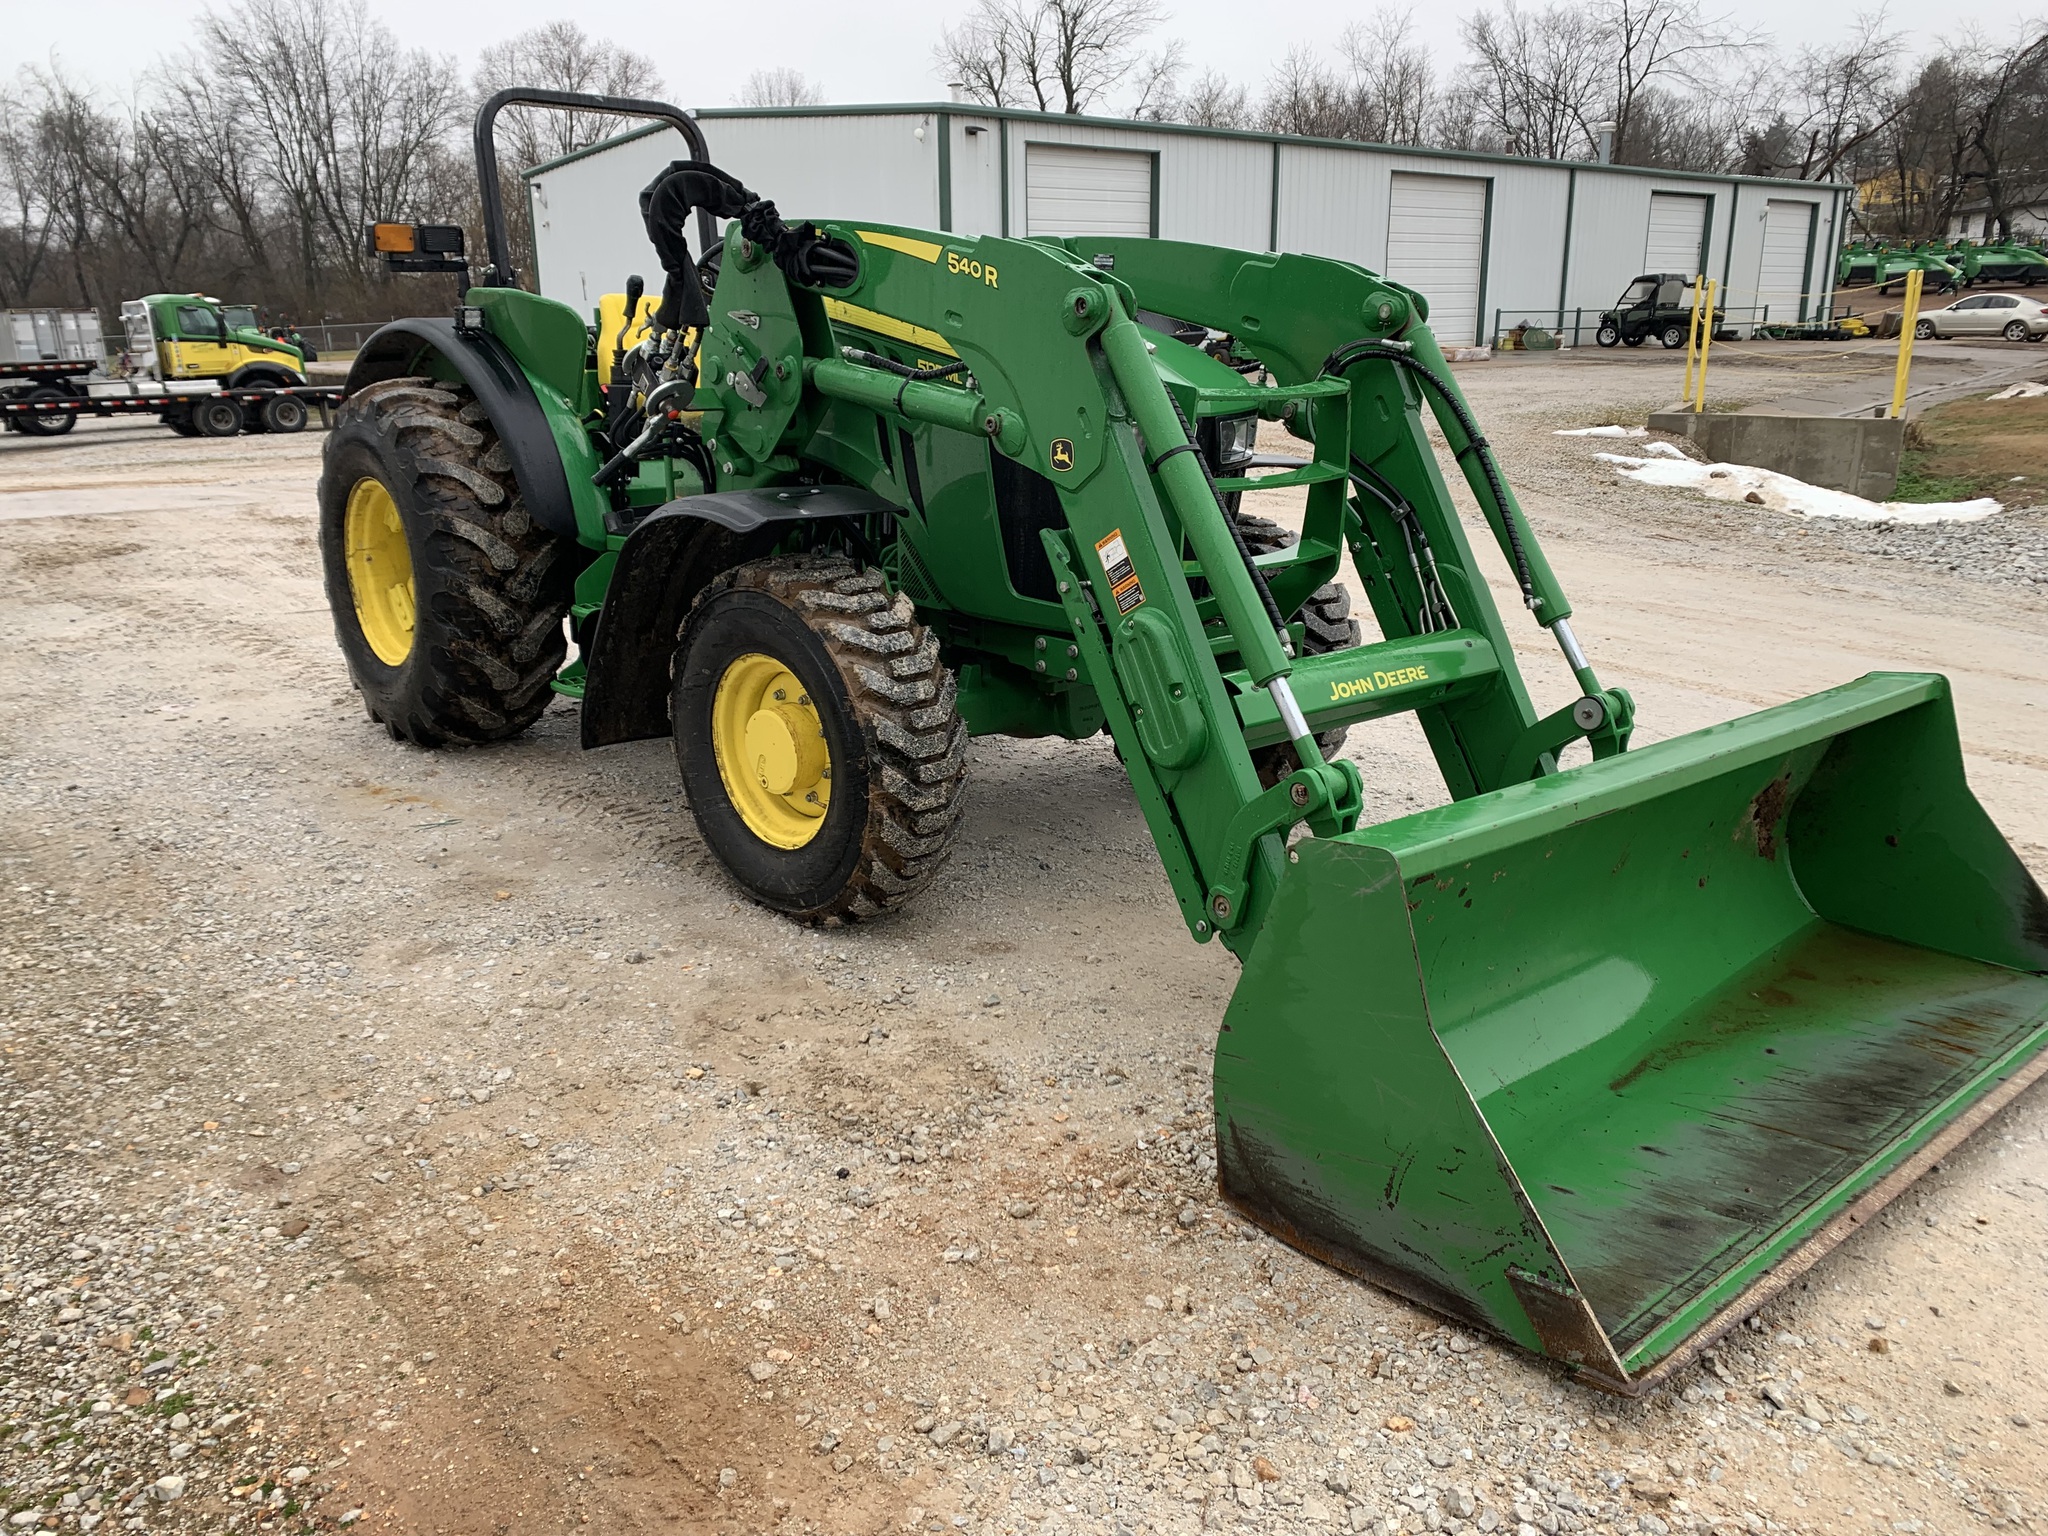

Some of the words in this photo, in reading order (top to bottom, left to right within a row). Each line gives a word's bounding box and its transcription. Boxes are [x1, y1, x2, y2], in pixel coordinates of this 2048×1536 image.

[947, 251, 982, 278] 540
[985, 264, 999, 289] R
[1330, 677, 1375, 701] JOHN
[1373, 665, 1429, 690] DEERE
